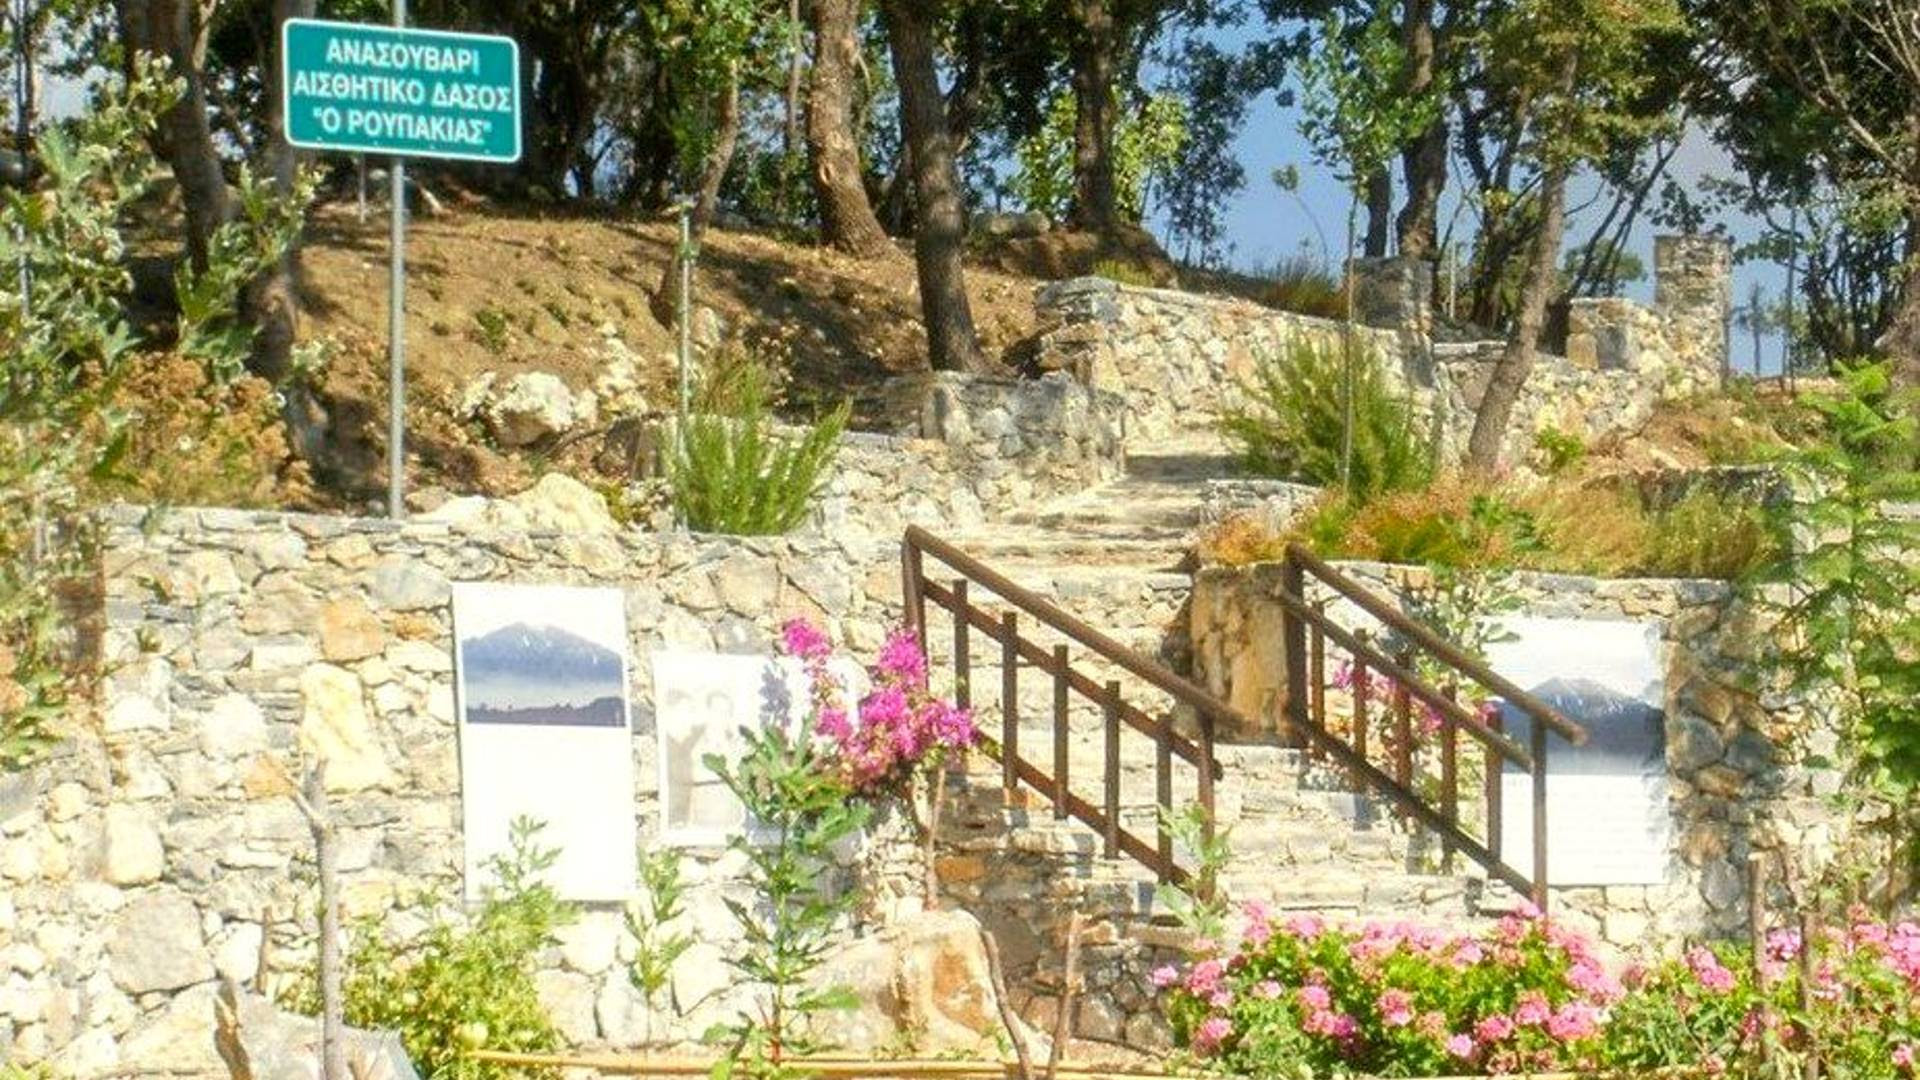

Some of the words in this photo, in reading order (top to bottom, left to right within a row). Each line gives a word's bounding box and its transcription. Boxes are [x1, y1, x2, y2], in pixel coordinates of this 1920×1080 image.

[326, 38, 479, 75] ΑΝΑΣΟΥΒΑΡΙ
[293, 71, 425, 105] ΑΙΣΘΗΤΙΚΟ
[431, 82, 511, 112] ΔΑΣΟΣ
